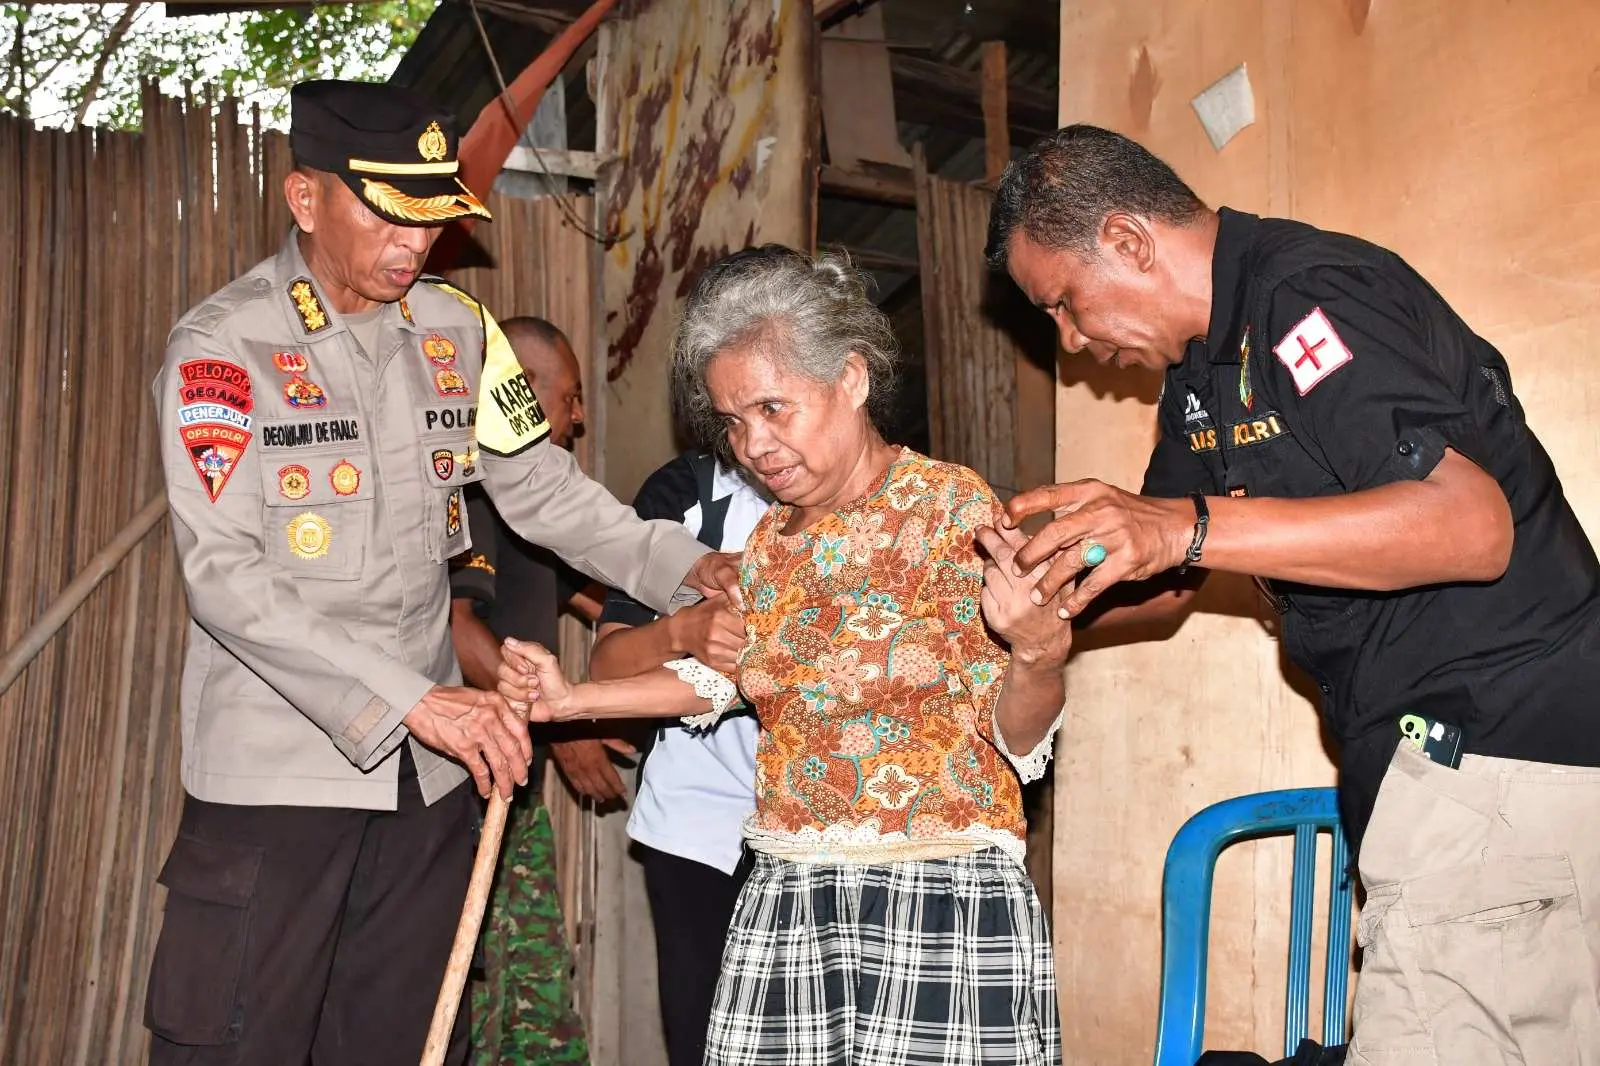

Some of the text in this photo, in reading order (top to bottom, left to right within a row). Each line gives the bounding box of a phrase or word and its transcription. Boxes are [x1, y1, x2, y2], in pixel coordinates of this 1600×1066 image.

[187, 362, 250, 392] PELOPOR
[186, 387, 247, 409] GEGANA
[186, 428, 245, 445] OPS POLRI
[508, 413, 530, 437] OPS
